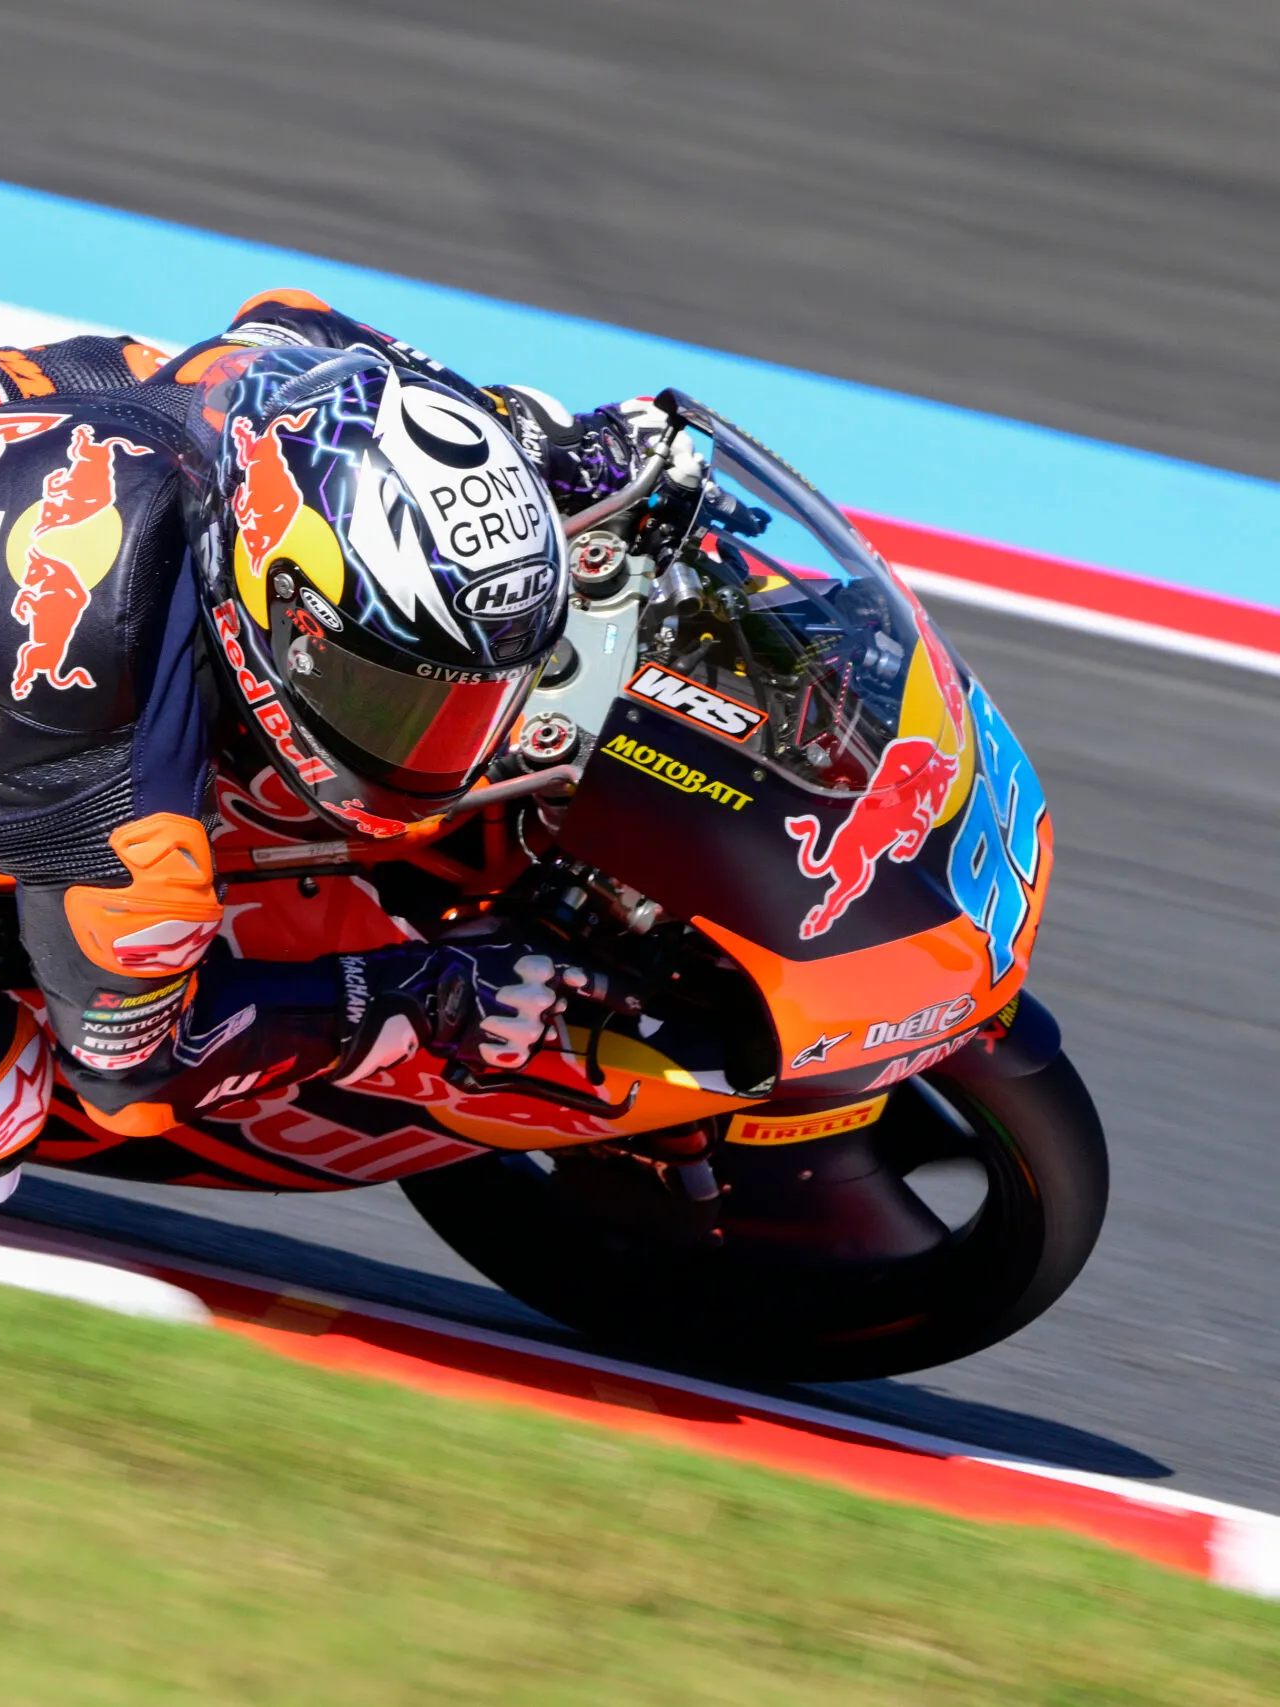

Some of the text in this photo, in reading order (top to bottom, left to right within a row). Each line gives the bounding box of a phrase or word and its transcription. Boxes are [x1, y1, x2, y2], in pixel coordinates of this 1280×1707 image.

[430, 466, 529, 522] PONT
[449, 500, 541, 558] GRUP
[473, 566, 550, 612] HJC
[212, 598, 276, 705] Red
[253, 700, 338, 786] Bull
[416, 664, 482, 685] GIVES
[630, 669, 761, 736] WRS
[601, 733, 754, 811] MOTOBATT
[862, 1027, 980, 1093] AVANT
[741, 1106, 873, 1140] PIRELLI
